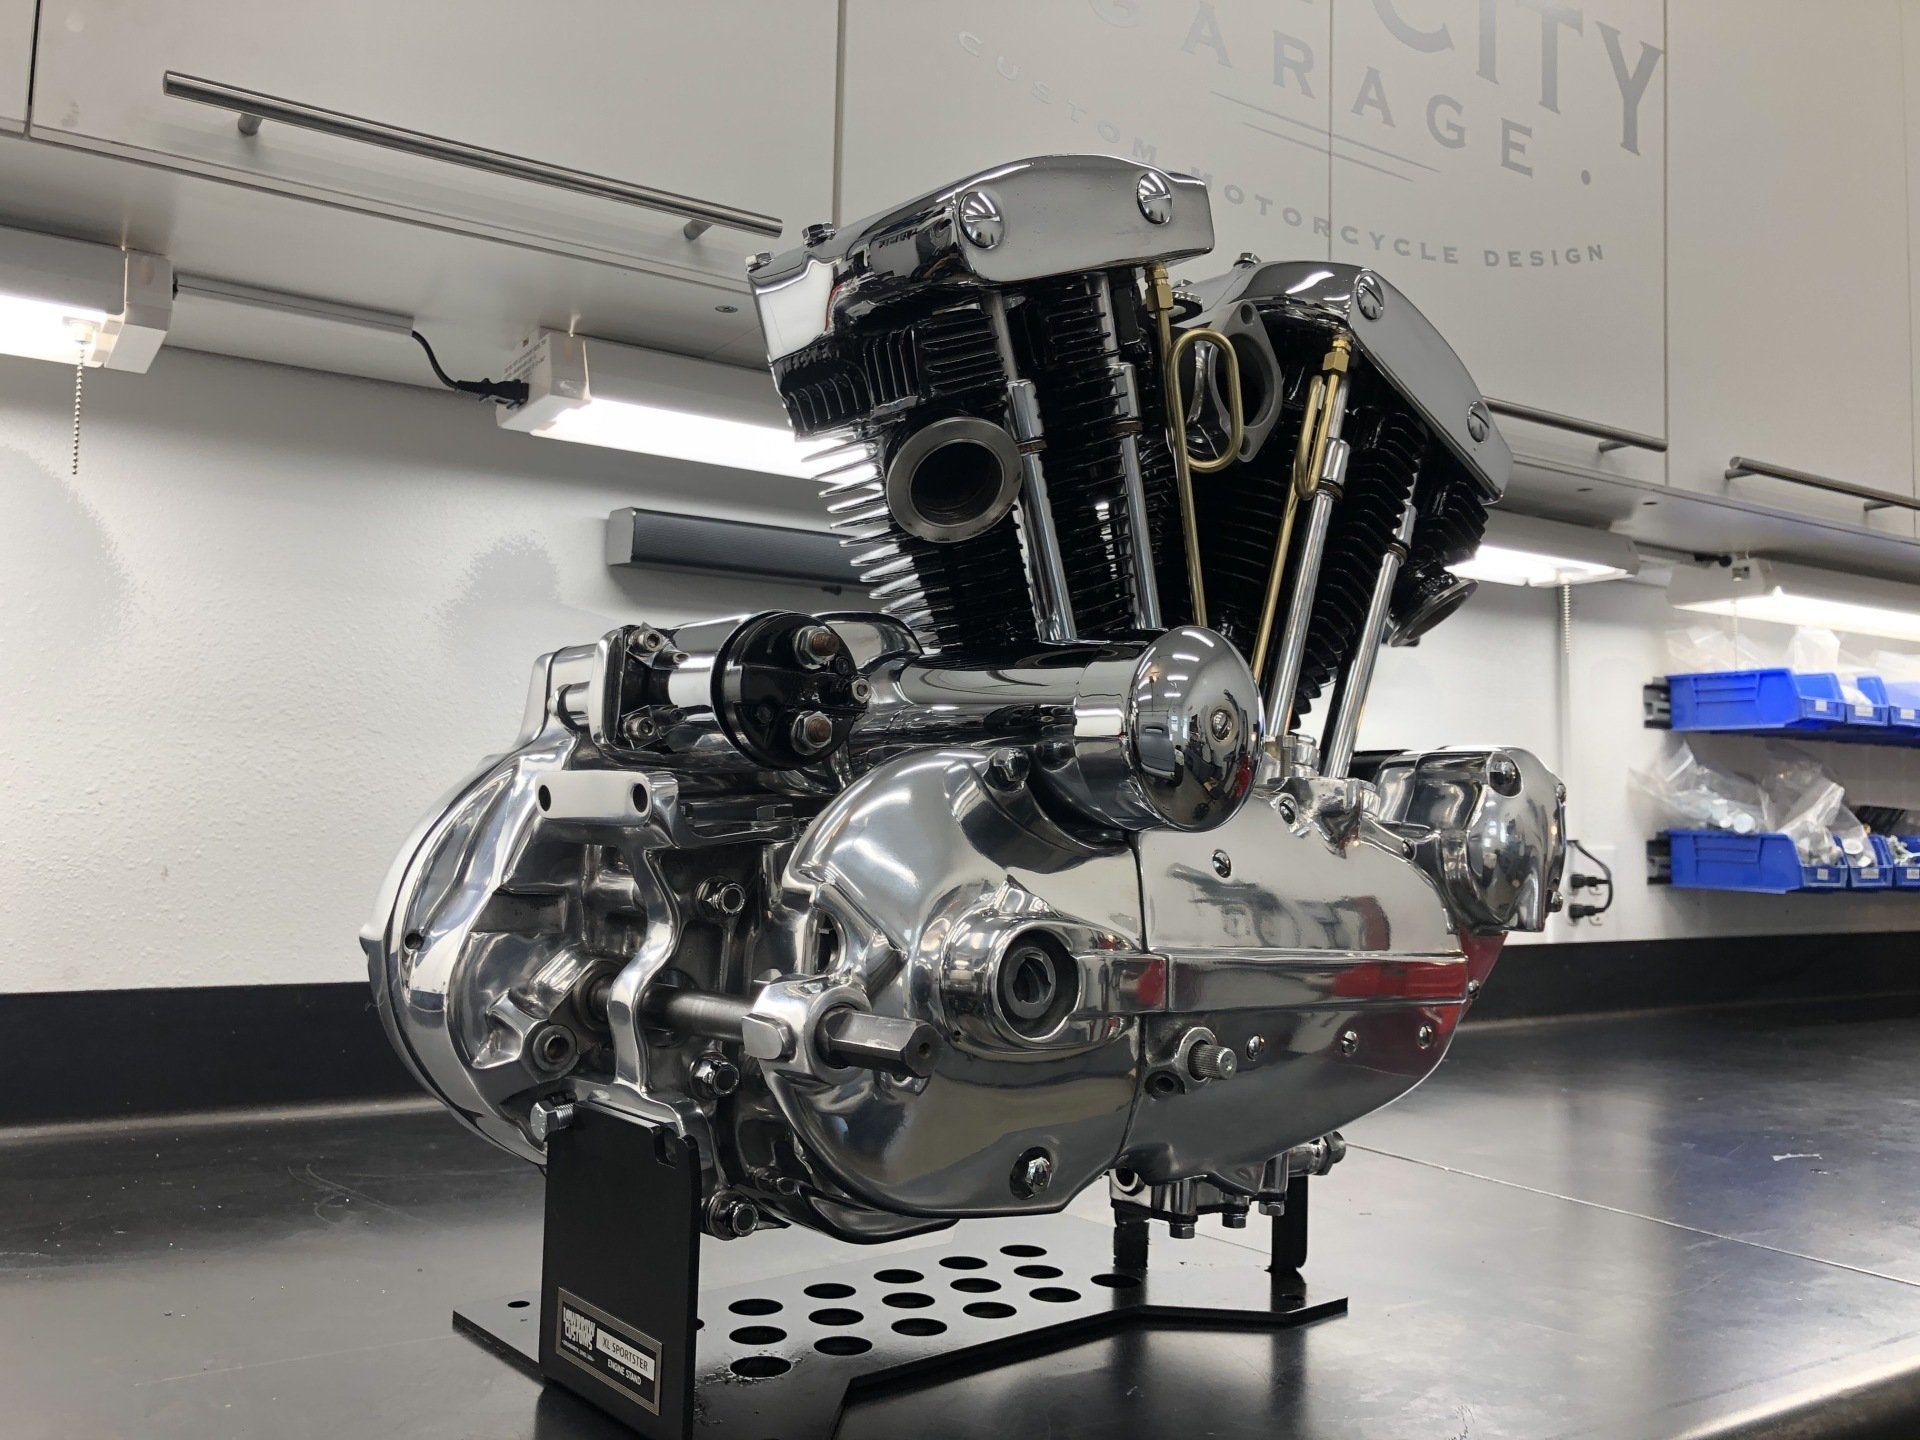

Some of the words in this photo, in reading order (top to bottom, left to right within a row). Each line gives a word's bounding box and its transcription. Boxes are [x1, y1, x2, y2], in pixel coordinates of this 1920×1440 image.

[958, 30, 1157, 163] CUSTOM
[1190, 167, 1459, 264] MOTORCYCLE
[1483, 244, 1604, 267] DESIGN
[602, 1336, 610, 1350] XL
[612, 1342, 649, 1371] SPORTSTER
